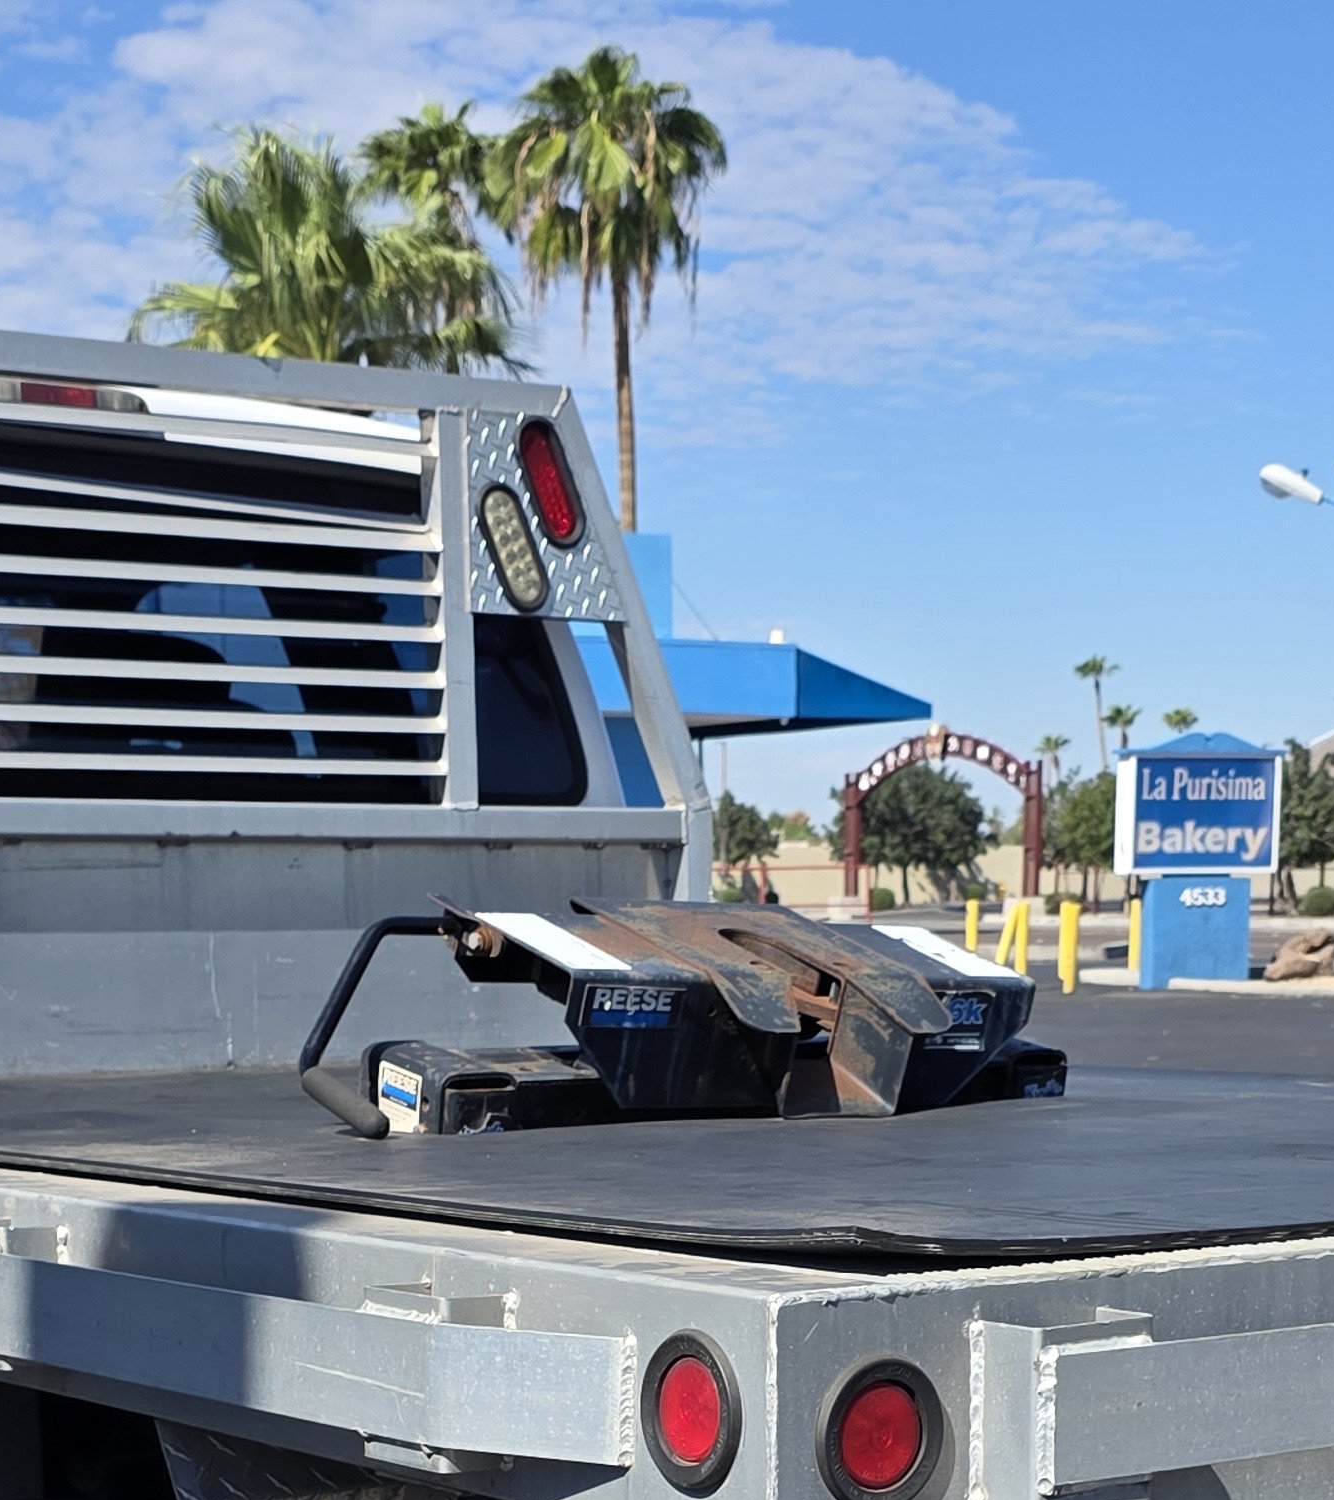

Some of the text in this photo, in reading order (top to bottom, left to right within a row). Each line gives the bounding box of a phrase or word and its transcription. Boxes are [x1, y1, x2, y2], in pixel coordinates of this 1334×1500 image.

[1141, 766, 1266, 801] La Purisima
[1136, 820, 1269, 862] Bakery
[1178, 886, 1227, 907] 4533
[592, 988, 676, 1011] REESE
[945, 997, 988, 1025] 6k
